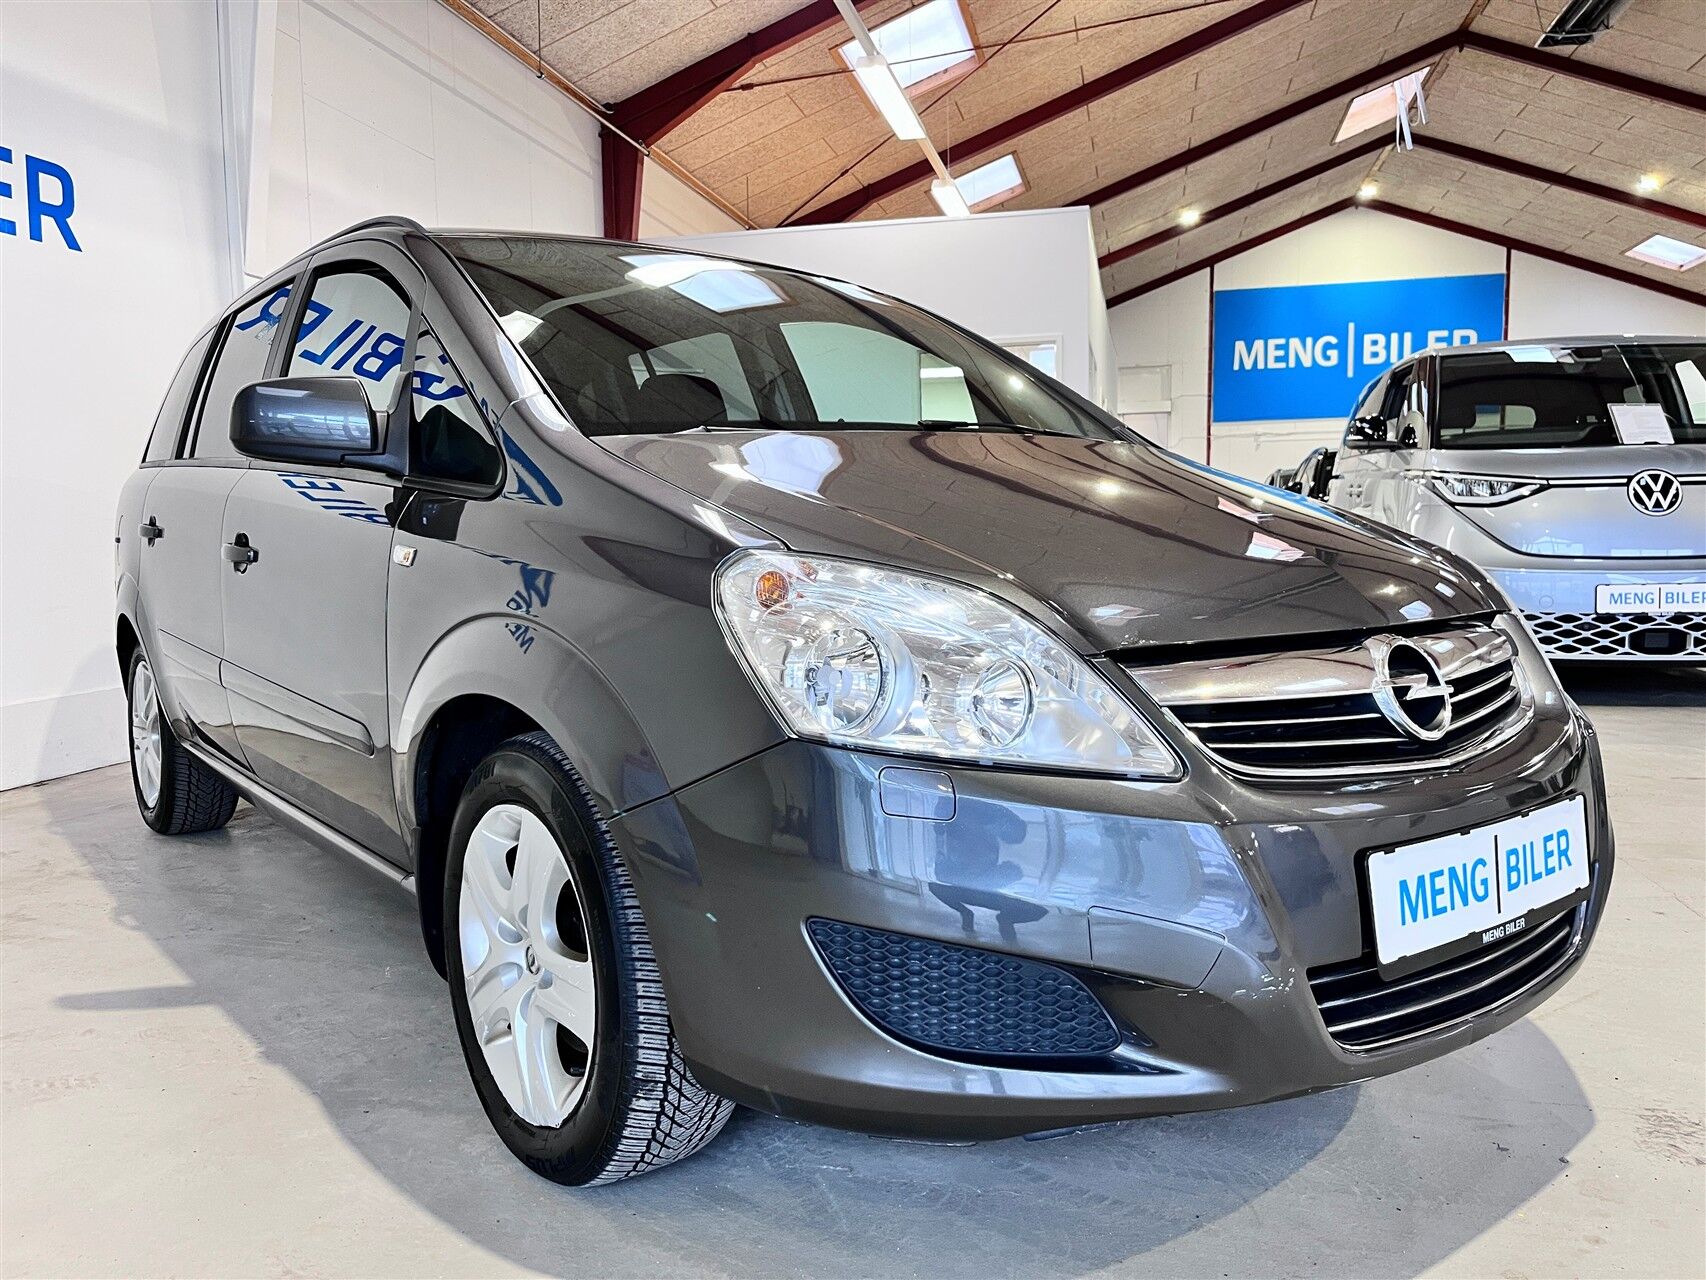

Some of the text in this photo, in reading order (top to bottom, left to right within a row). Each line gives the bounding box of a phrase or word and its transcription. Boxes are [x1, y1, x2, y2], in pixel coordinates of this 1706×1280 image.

[1233, 336, 1339, 371] MENG
[1609, 592, 1655, 605] MENG
[1399, 828, 1572, 926] MENG BILER
[1482, 917, 1526, 944] MENG BILER
